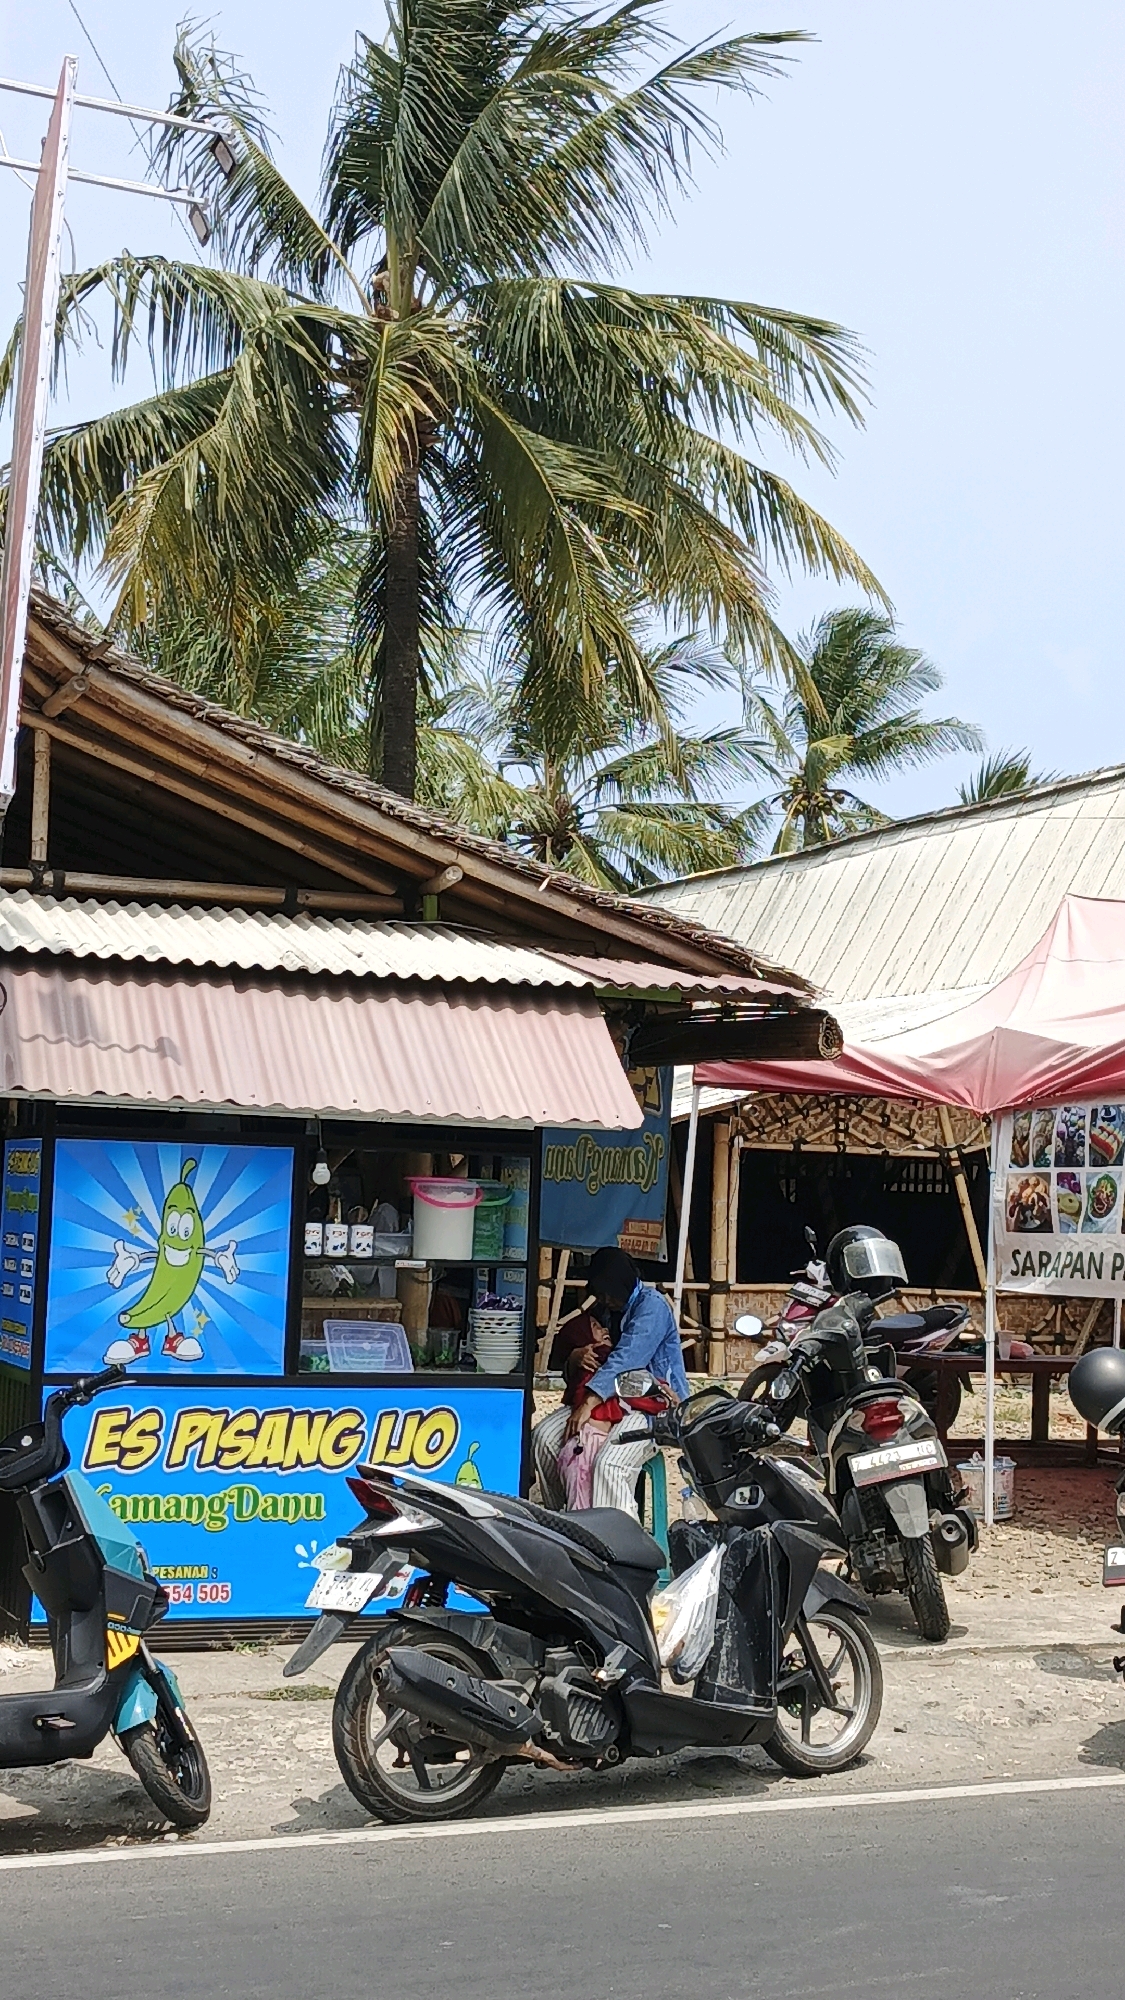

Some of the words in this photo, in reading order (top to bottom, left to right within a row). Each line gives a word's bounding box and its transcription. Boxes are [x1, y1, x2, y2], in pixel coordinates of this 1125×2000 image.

[1010, 1249, 1104, 1279] SARAPAN
[1111, 1252, 1125, 1280] P
[84, 1407, 164, 1470] ES
[165, 1407, 366, 1472] PISANG
[368, 1407, 459, 1470] IJO
[197, 1583, 232, 1604] 505
